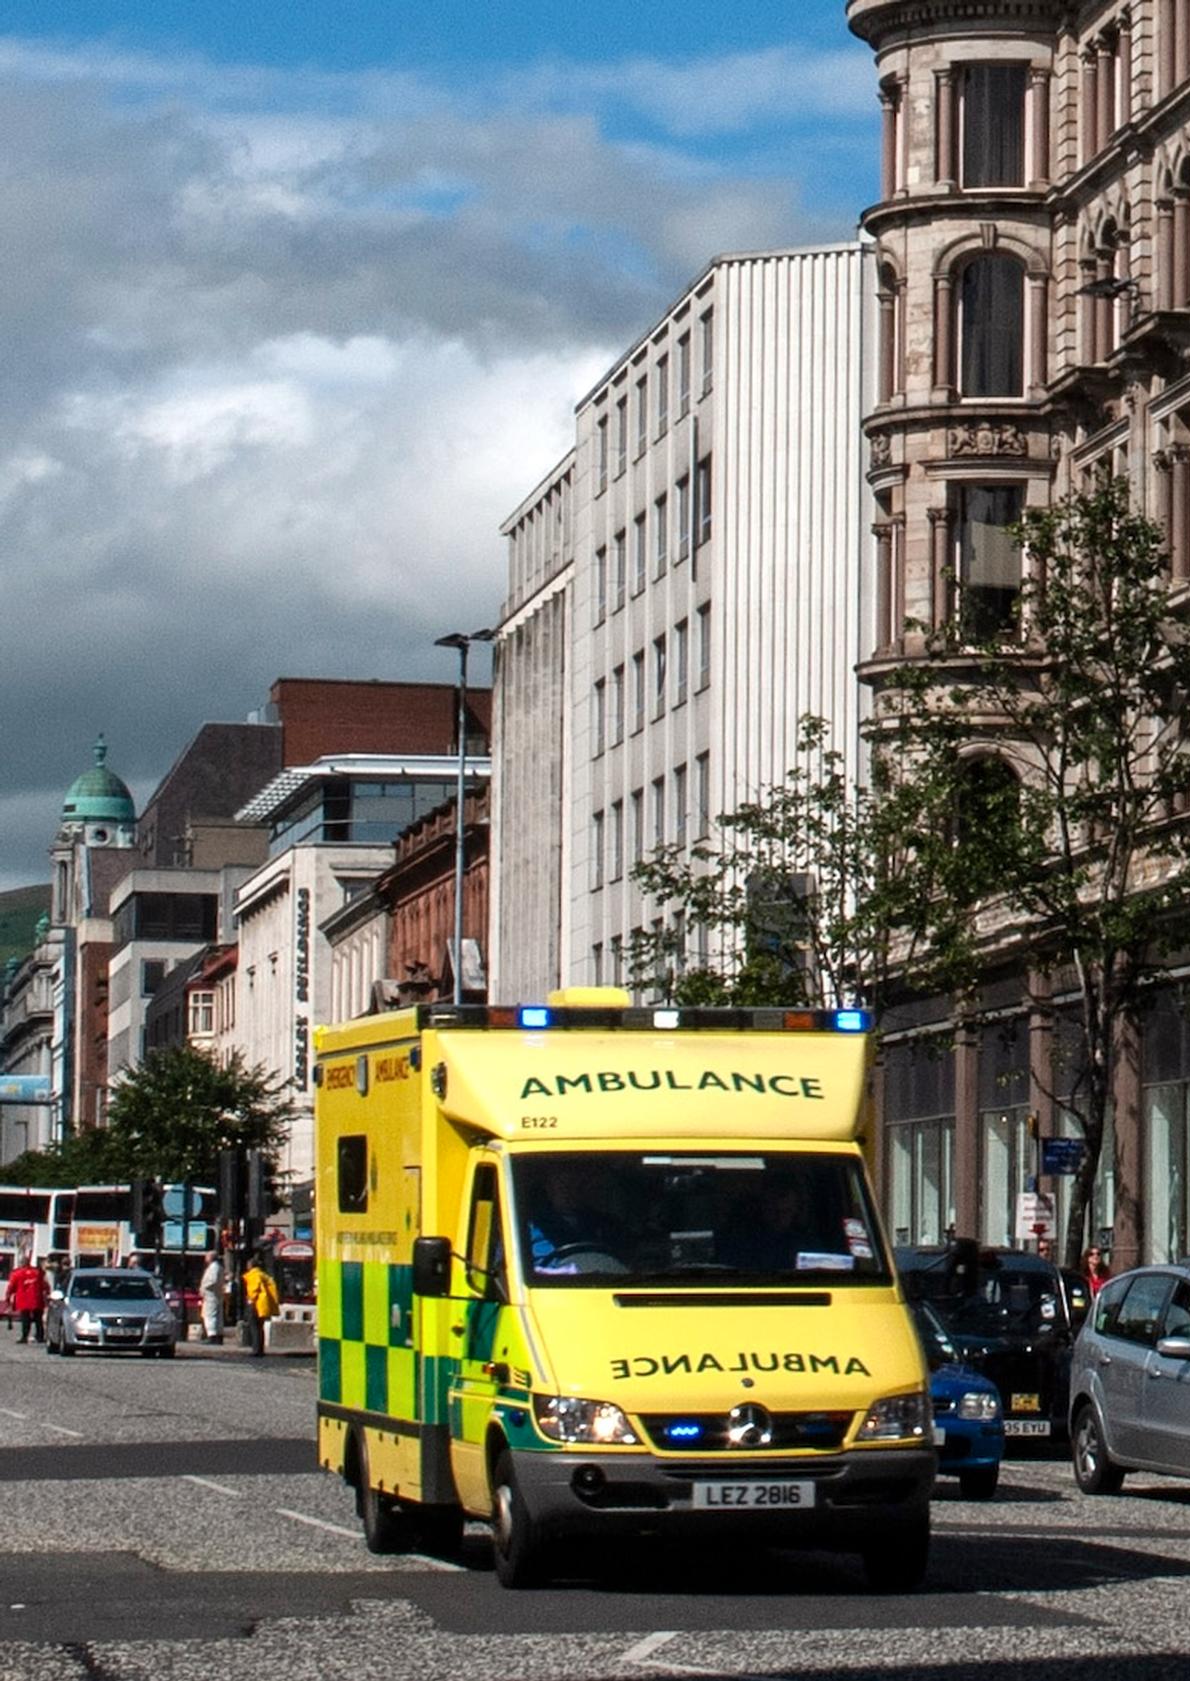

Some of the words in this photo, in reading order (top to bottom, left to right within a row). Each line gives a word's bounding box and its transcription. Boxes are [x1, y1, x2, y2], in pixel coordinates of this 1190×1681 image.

[295, 887, 310, 1003] BUILDINGS
[326, 1065, 354, 1090] EMERGENC
[520, 1070, 824, 1100] AMBULANCE
[521, 1116, 558, 1129] E122
[706, 1485, 749, 1506] LEZ
[754, 1484, 802, 1505] 2816
